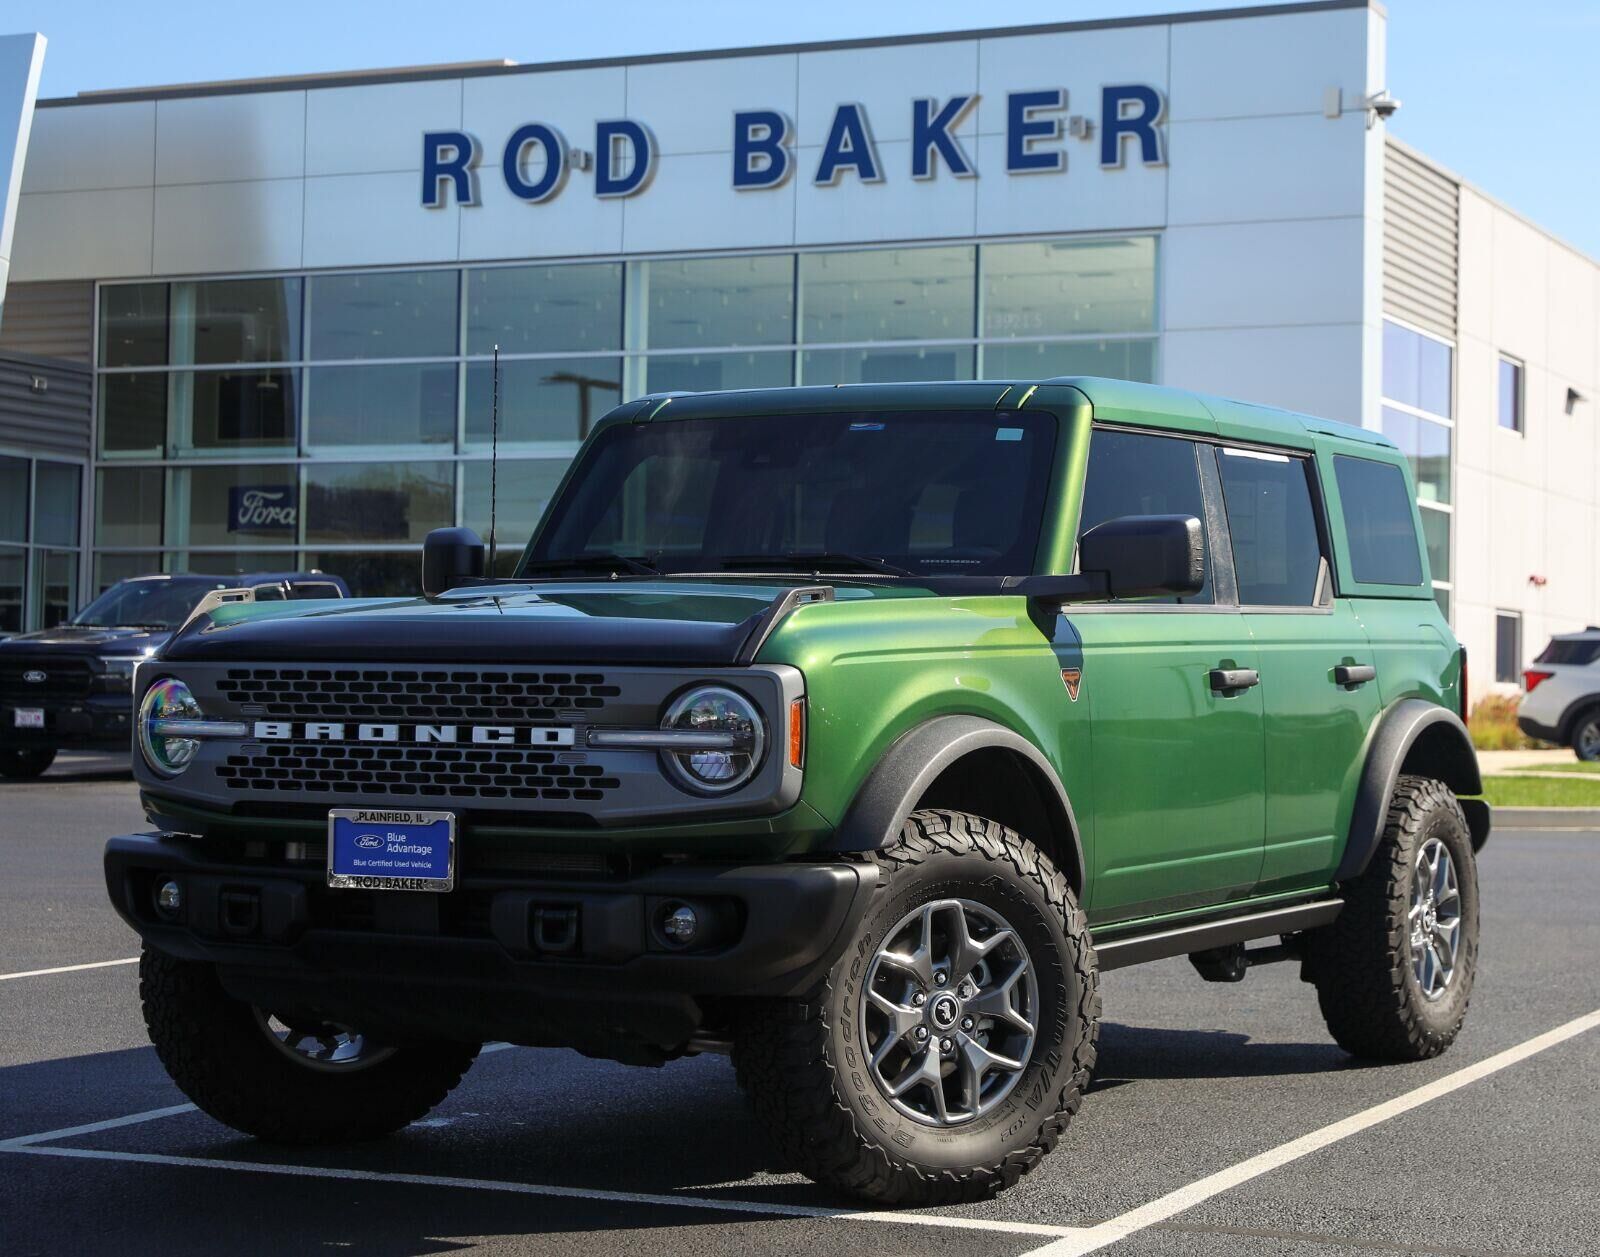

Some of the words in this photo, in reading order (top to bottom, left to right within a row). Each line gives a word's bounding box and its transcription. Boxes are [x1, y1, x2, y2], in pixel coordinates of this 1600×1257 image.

[422, 119, 656, 207] ROD
[732, 84, 1167, 189] BAKER
[254, 721, 575, 746] BRONCO
[359, 812, 413, 823] PLAINFIELD,
[416, 815, 424, 823] IL
[357, 836, 381, 848] Ford
[387, 833, 406, 842] Blue
[387, 844, 432, 855] Advantage
